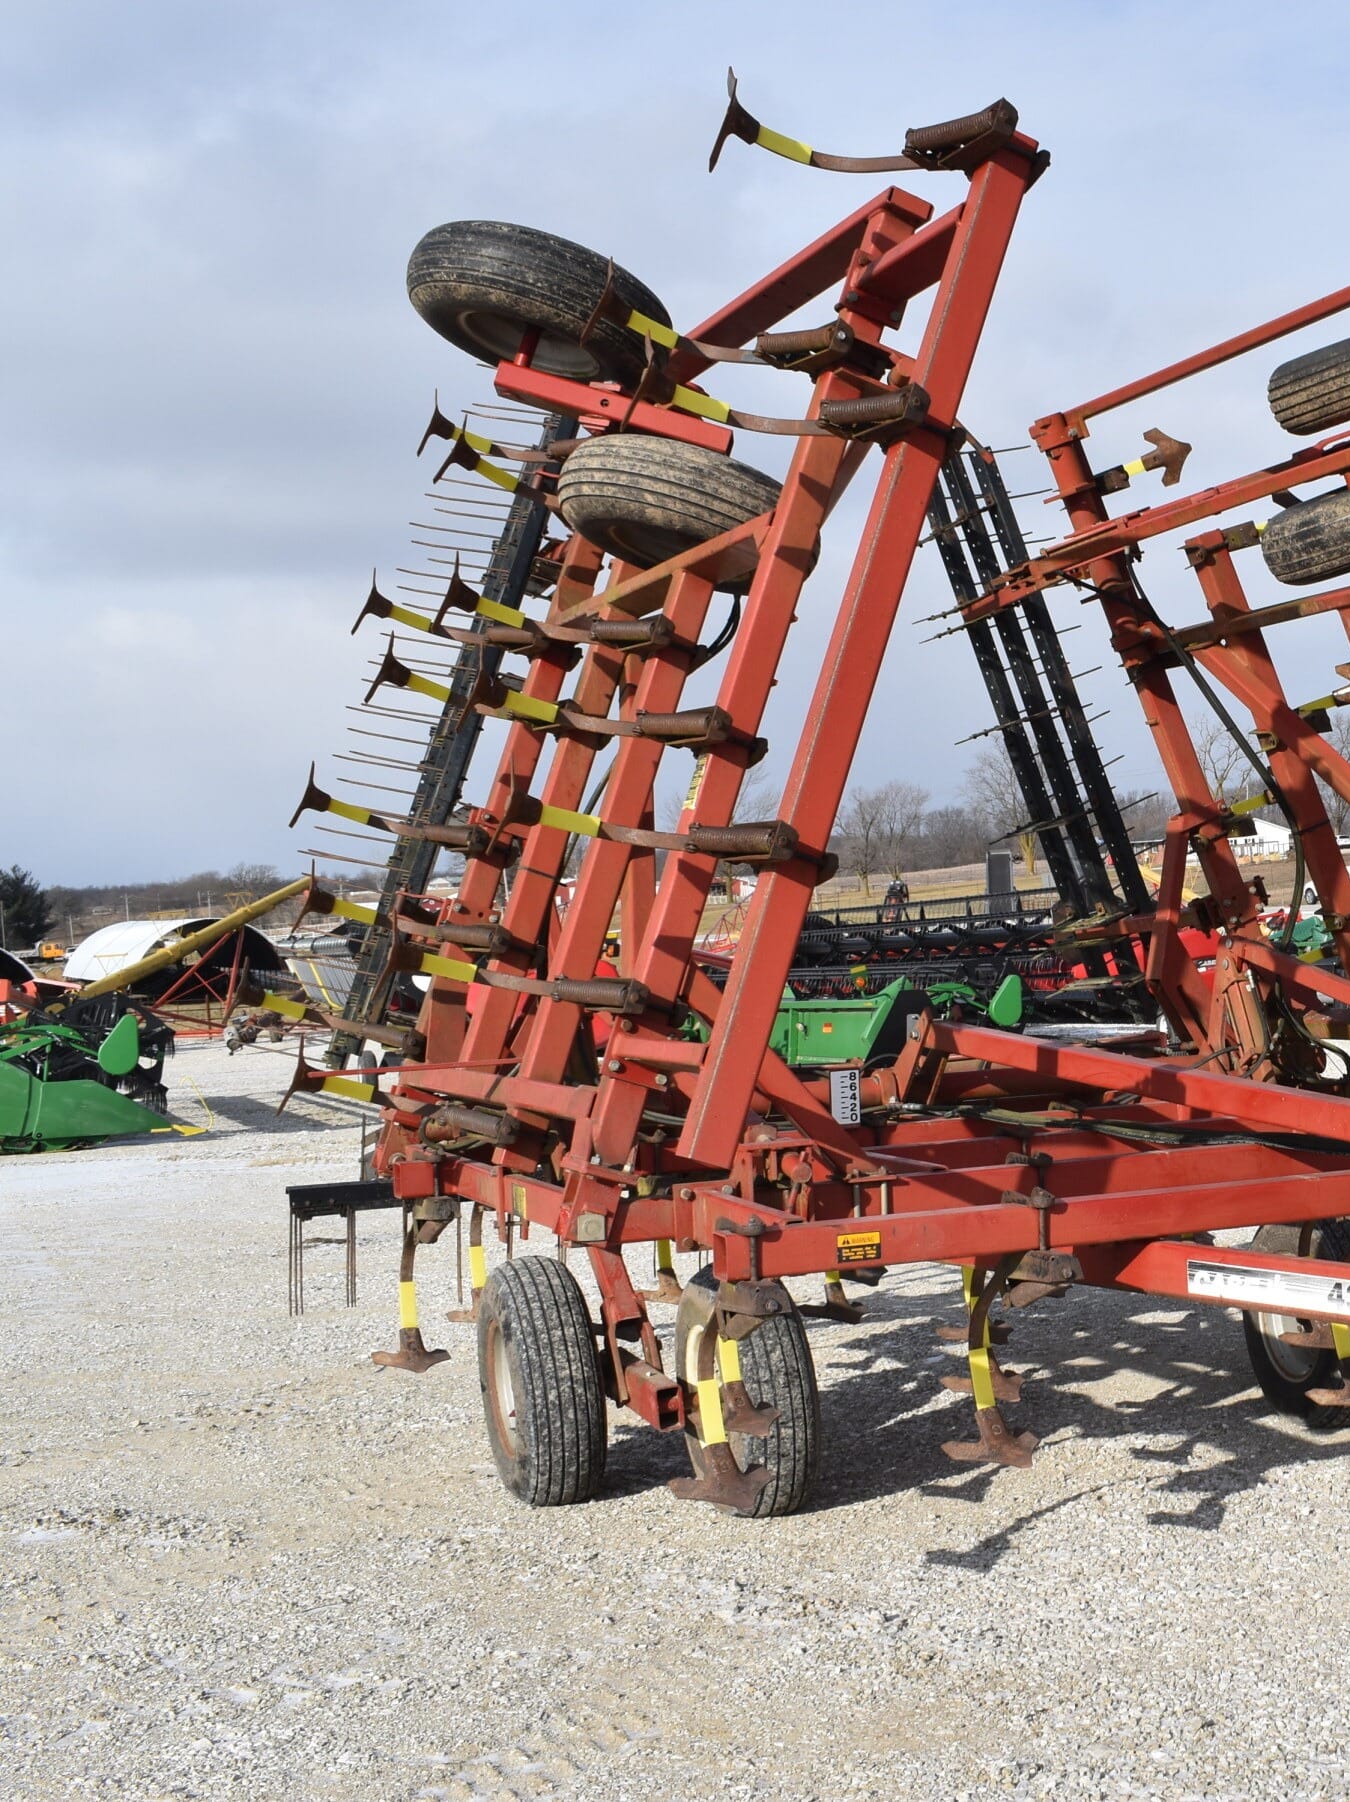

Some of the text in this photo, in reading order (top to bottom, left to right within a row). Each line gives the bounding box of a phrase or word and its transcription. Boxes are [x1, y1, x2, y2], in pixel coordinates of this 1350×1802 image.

[849, 1072, 857, 1081] 8
[849, 1082, 858, 1091] 6
[850, 1092, 858, 1101] 4
[850, 1103, 858, 1112] 2
[850, 1112, 858, 1122] 0
